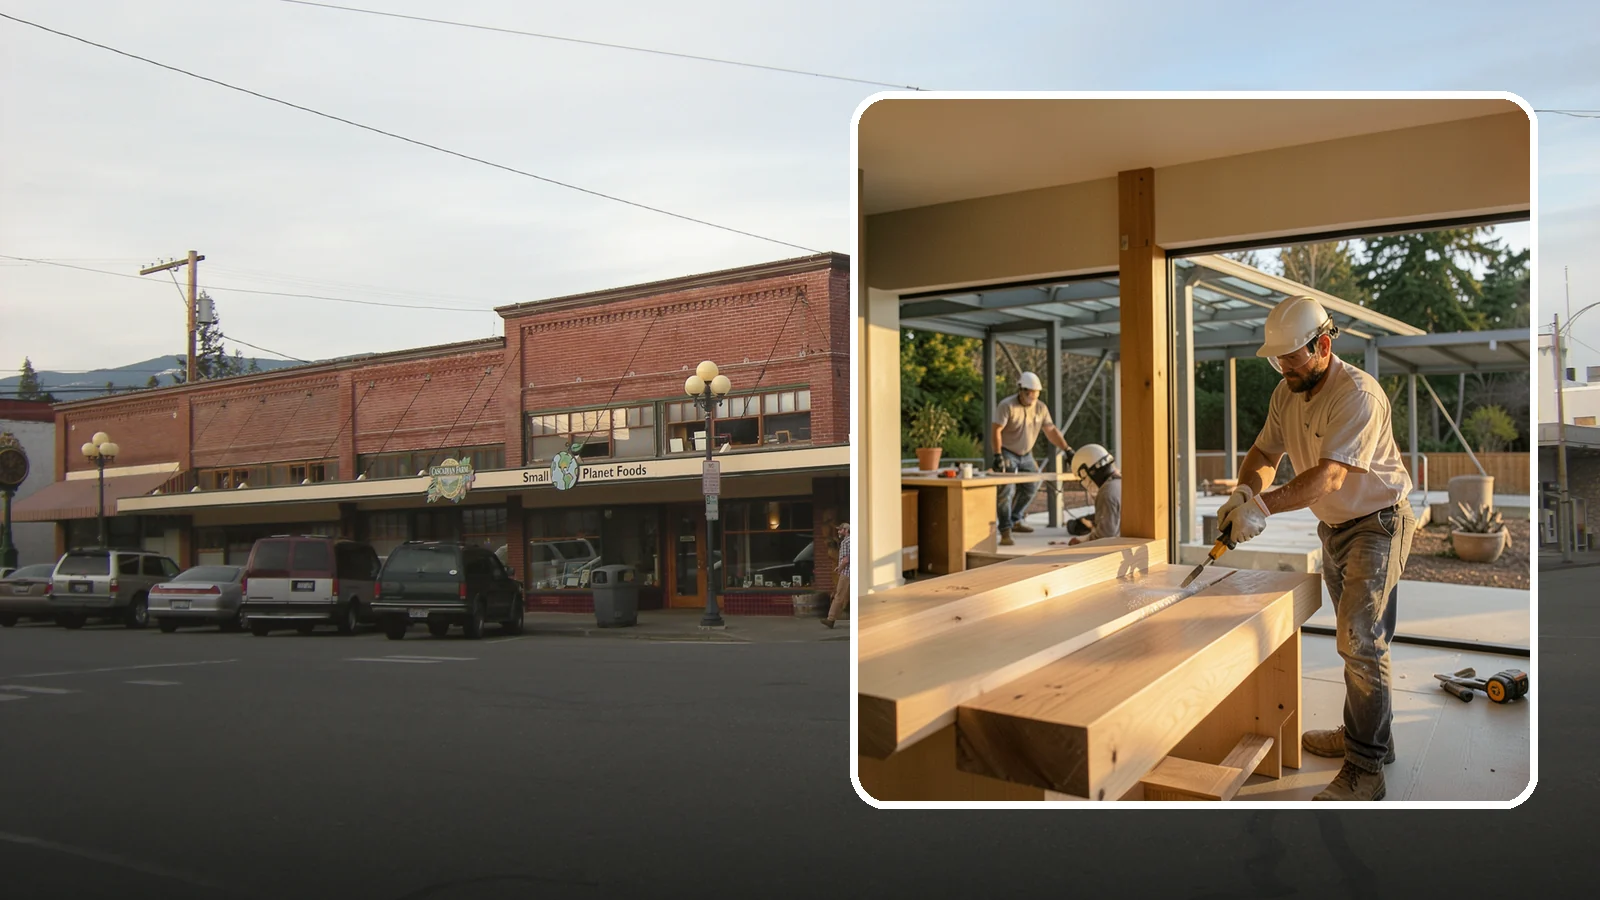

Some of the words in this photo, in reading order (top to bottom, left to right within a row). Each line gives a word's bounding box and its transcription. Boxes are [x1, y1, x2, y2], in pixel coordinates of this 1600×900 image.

[523, 471, 549, 482] Small
[583, 467, 614, 479] Planet
[617, 464, 647, 477] Foods
